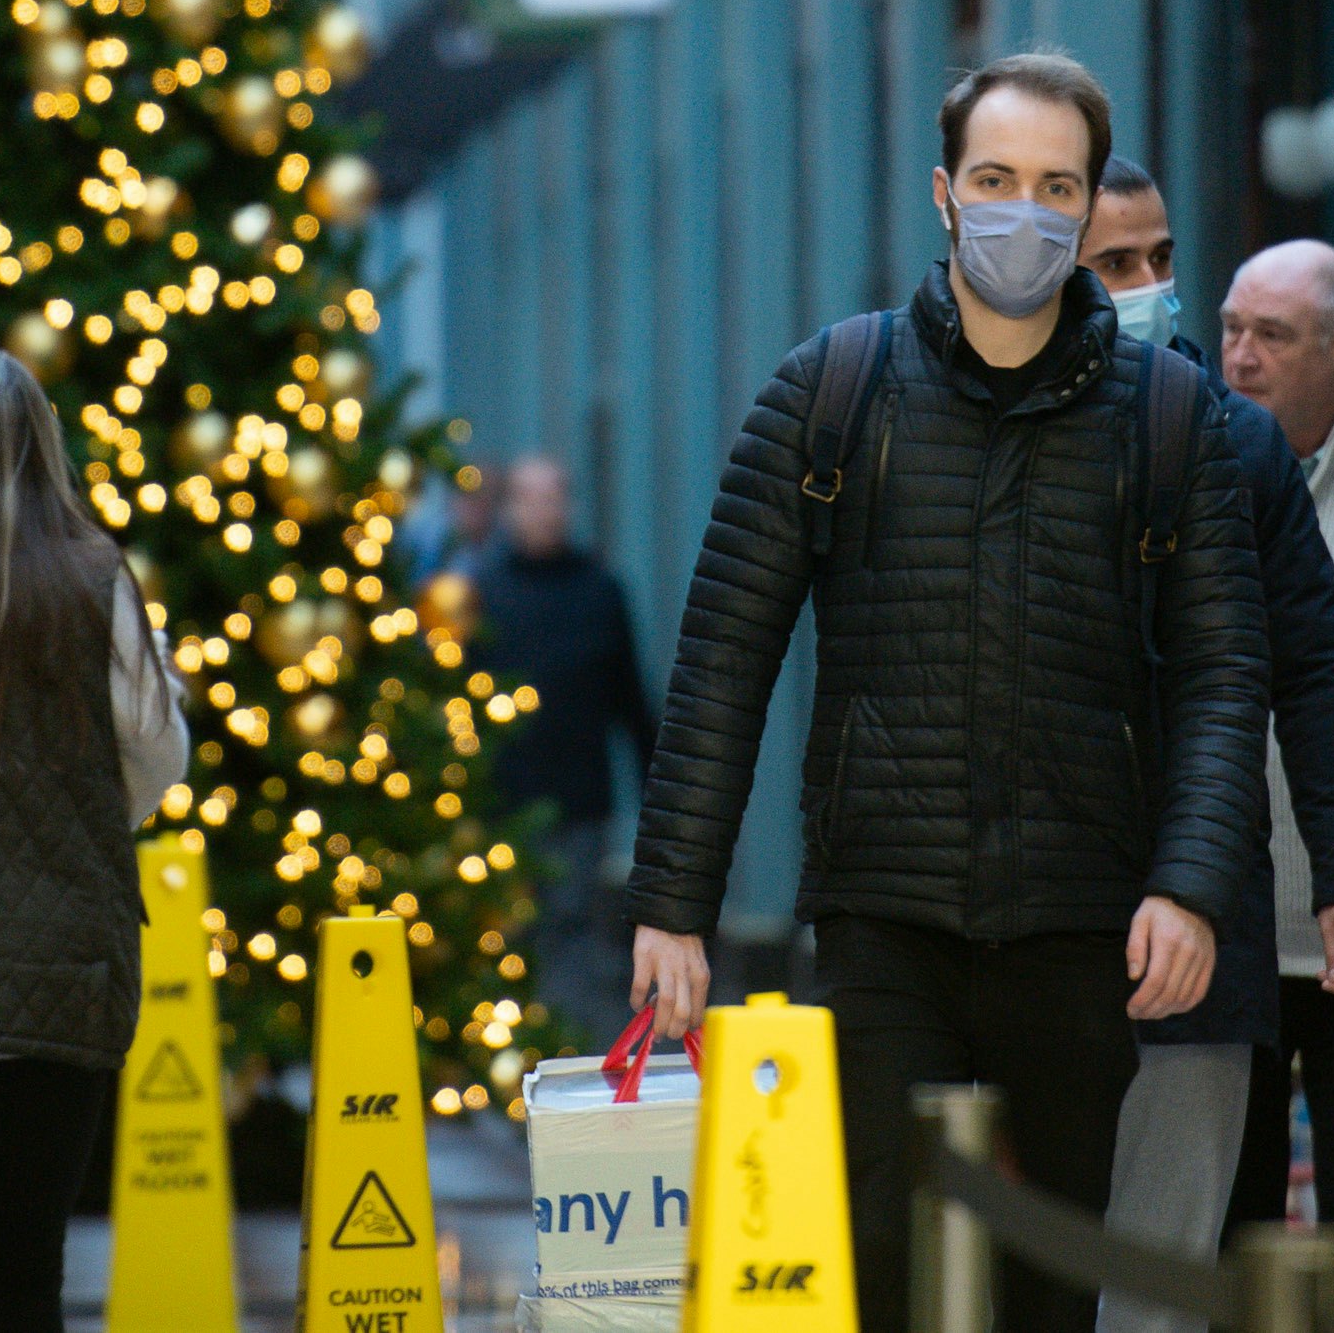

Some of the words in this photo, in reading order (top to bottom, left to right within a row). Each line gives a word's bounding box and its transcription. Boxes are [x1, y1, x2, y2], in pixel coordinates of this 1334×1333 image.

[340, 1093, 400, 1116] SIR
[737, 1264, 816, 1293] SIR
[328, 1286, 423, 1307] CAUTION
[344, 1311, 408, 1333] WET
